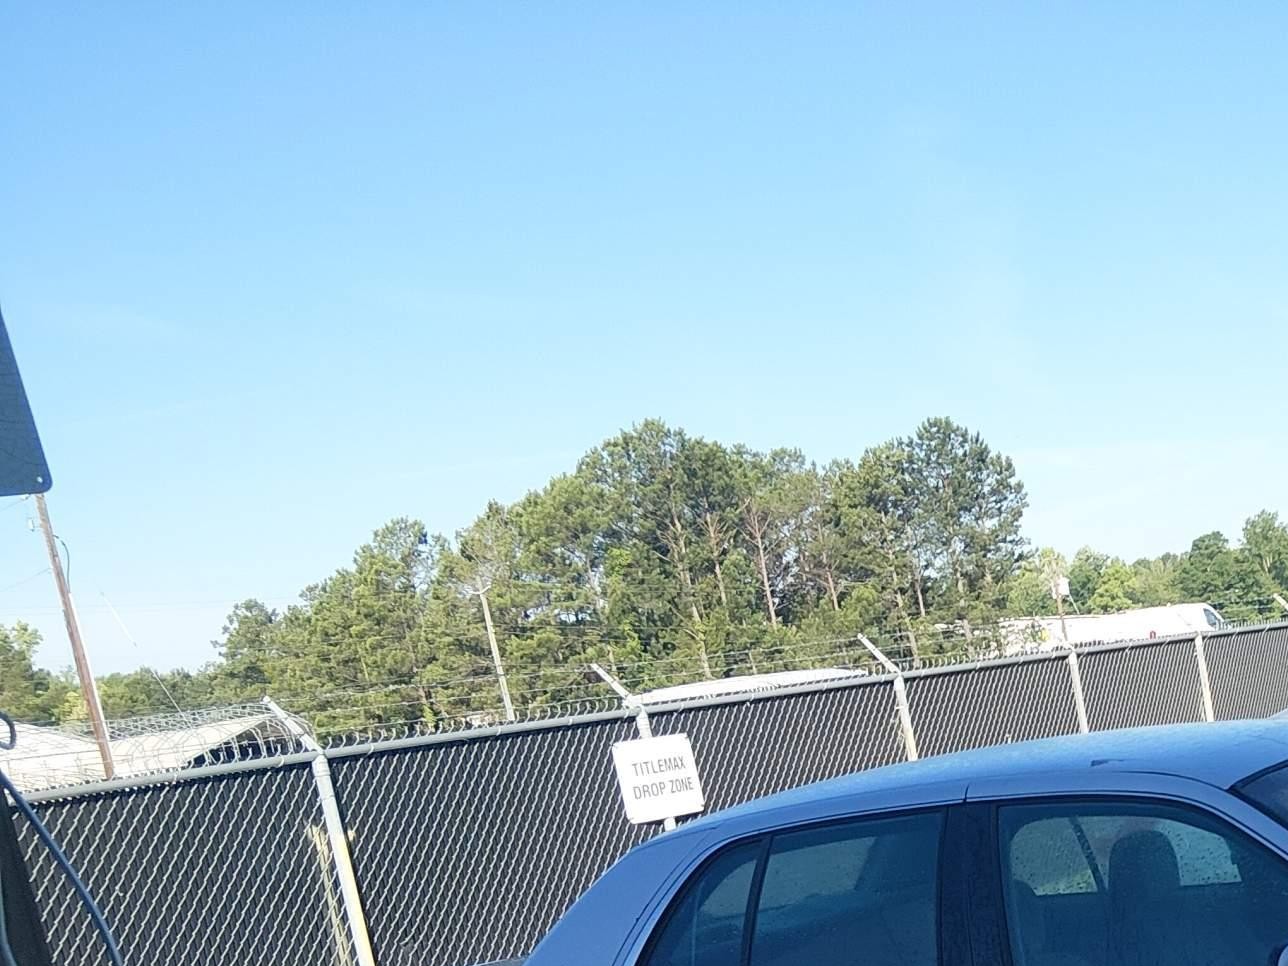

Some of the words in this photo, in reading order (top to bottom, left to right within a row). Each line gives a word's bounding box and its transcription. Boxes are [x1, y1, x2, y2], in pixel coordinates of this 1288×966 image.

[632, 756, 686, 776] TITLEMAX
[633, 781, 666, 800] DROP
[669, 777, 694, 794] ZONE
